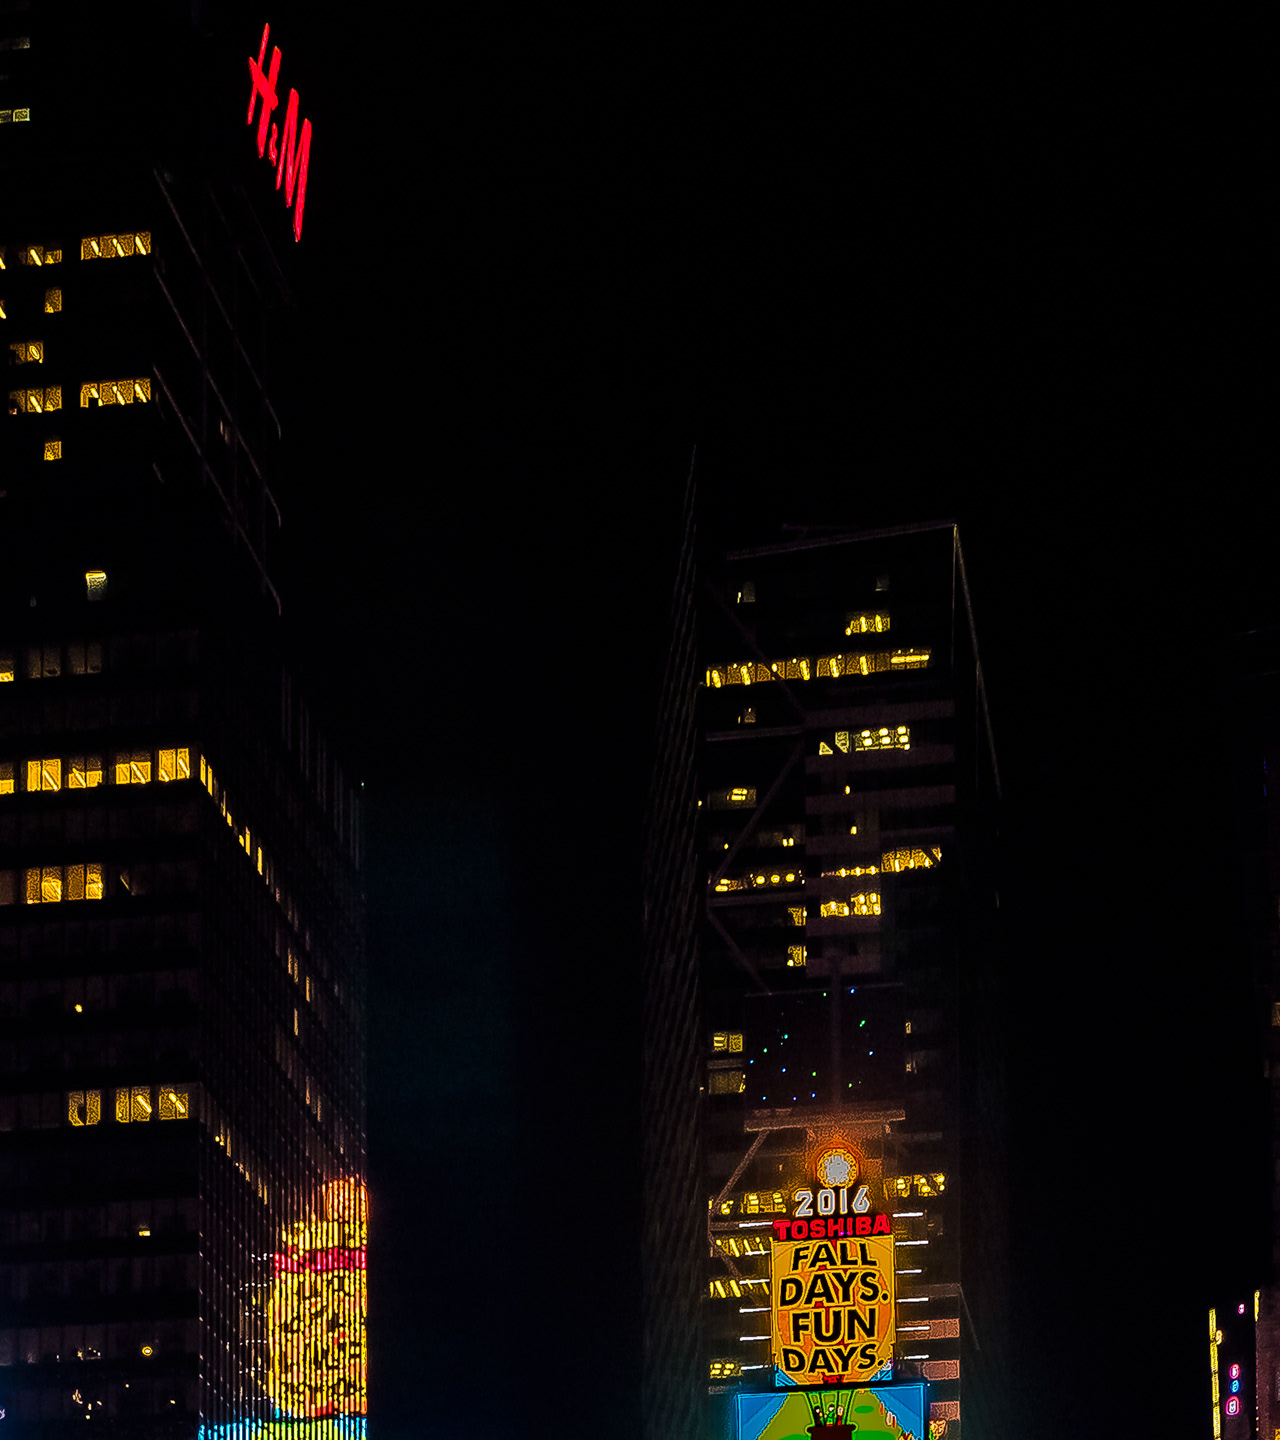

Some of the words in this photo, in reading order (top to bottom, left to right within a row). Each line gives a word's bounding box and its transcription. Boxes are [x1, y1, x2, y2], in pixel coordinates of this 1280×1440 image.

[247, 22, 312, 242] H&M
[794, 1187, 871, 1217] 2016
[773, 1213, 891, 1240] TOSHIBA
[791, 1240, 878, 1271] FALL
[780, 1269, 889, 1307] DAYS.
[792, 1307, 877, 1346] FUN
[782, 1344, 885, 1376] DAYS.
